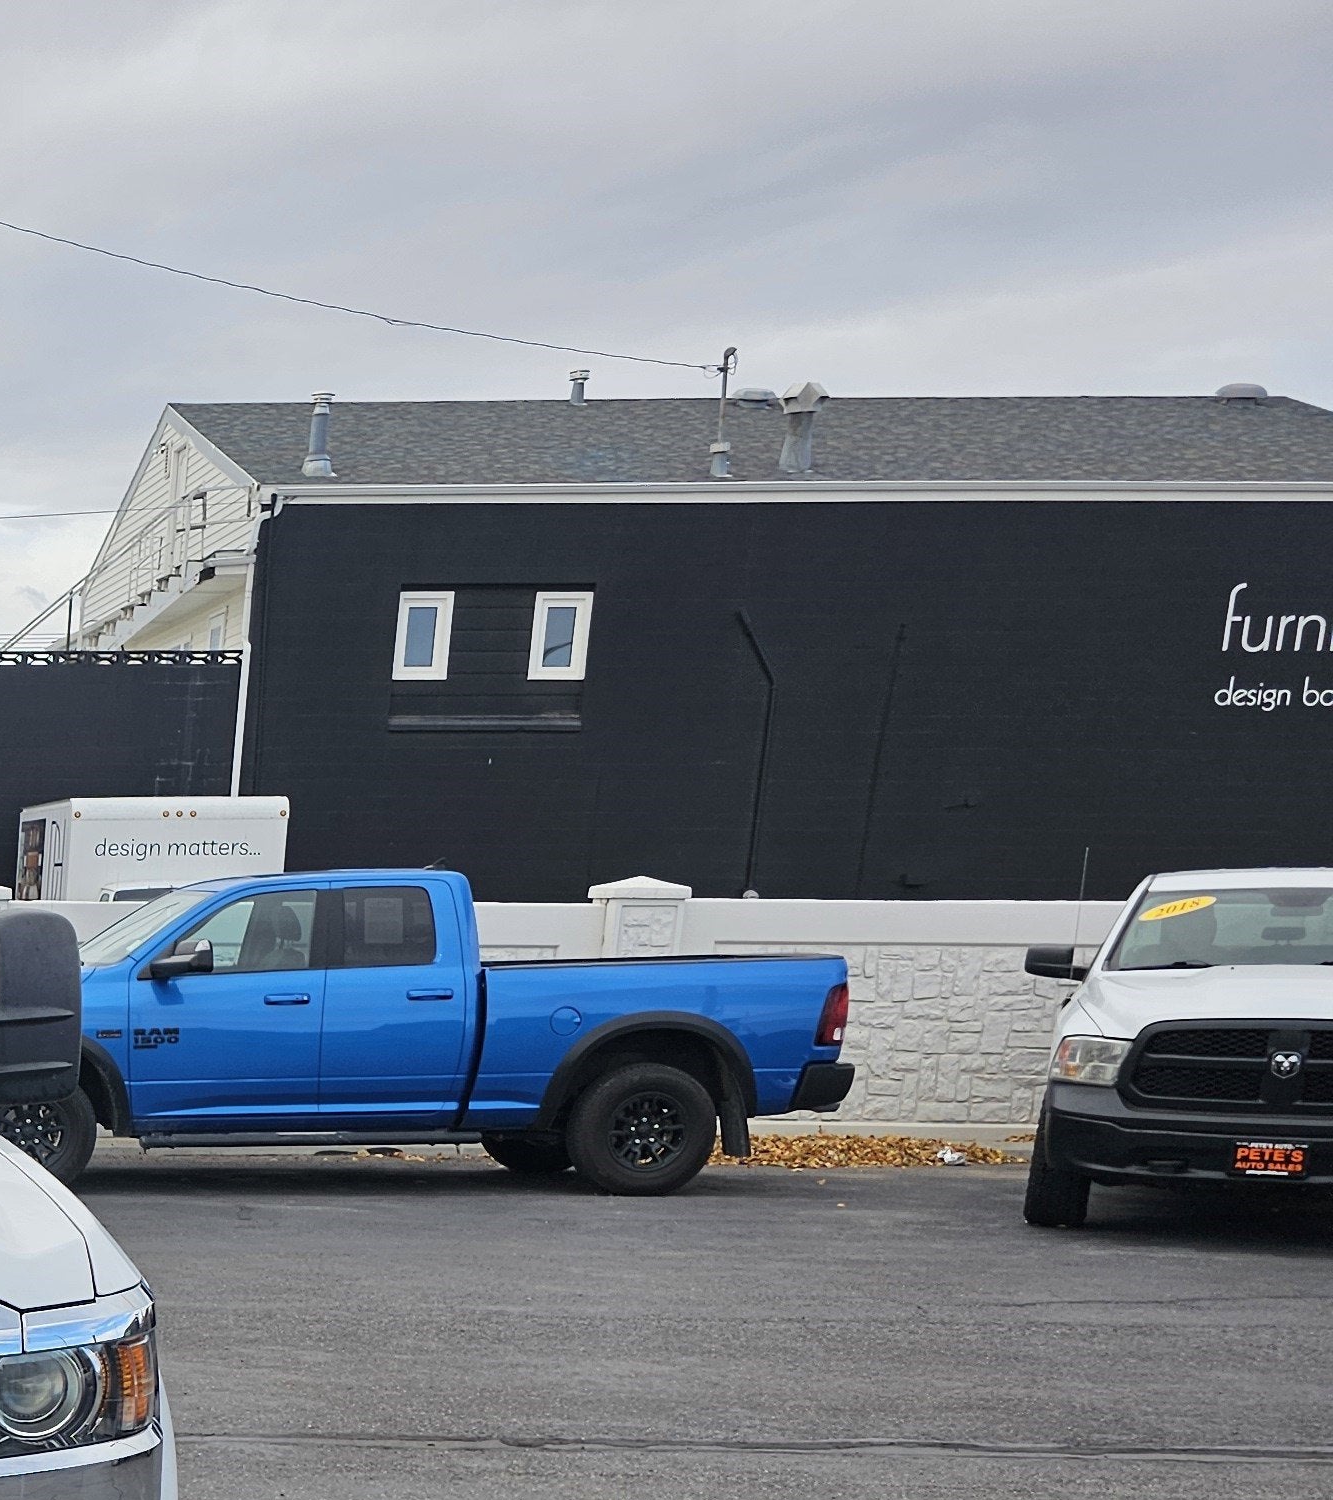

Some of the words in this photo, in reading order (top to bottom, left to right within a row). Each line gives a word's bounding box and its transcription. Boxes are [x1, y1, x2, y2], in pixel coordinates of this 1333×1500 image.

[1222, 582, 1333, 653] furn
[1214, 676, 1292, 712] design
[94, 838, 161, 862] design
[167, 839, 262, 856] matters...
[1235, 1161, 1265, 1170] AUTO
[1268, 1162, 1303, 1172] SALES
[1236, 1147, 1304, 1163] PETE'S
